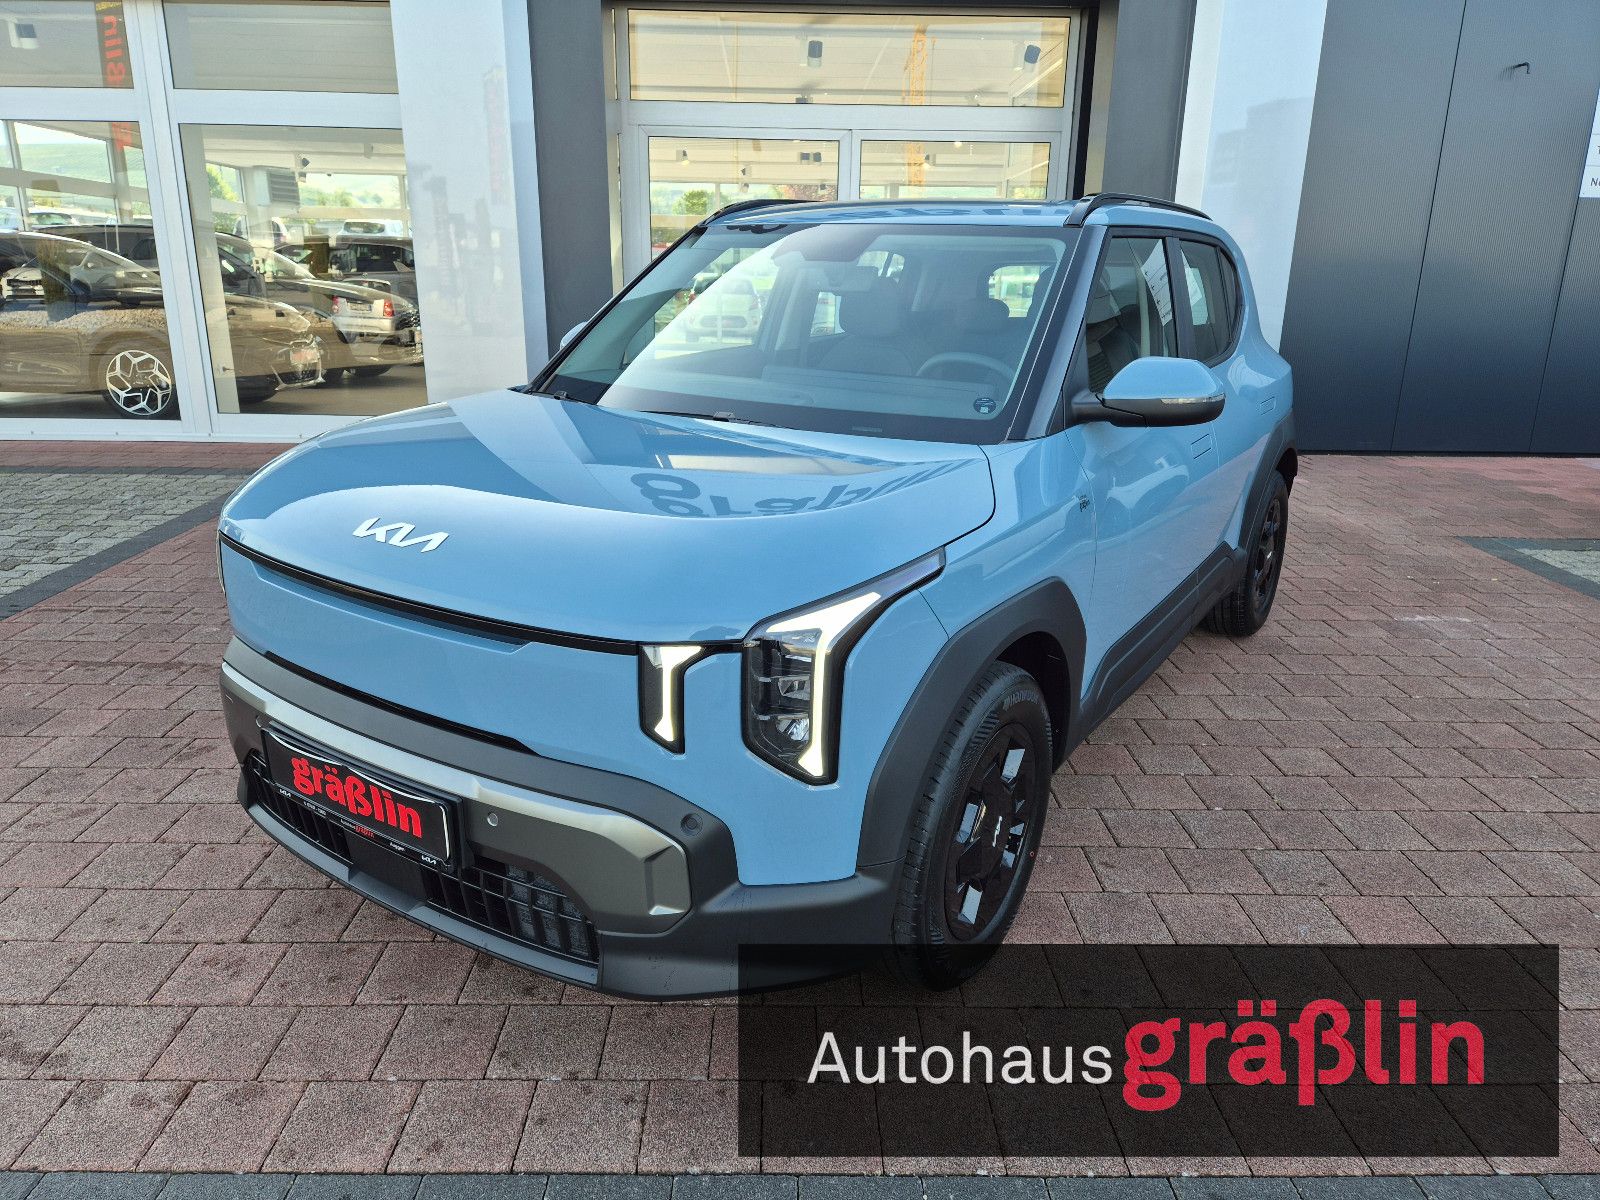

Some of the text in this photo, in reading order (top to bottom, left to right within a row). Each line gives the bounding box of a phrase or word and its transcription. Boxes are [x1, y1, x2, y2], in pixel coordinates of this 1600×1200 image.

[352, 517, 450, 553] KIA
[291, 757, 422, 838] gräßlin
[421, 854, 438, 866] KIA
